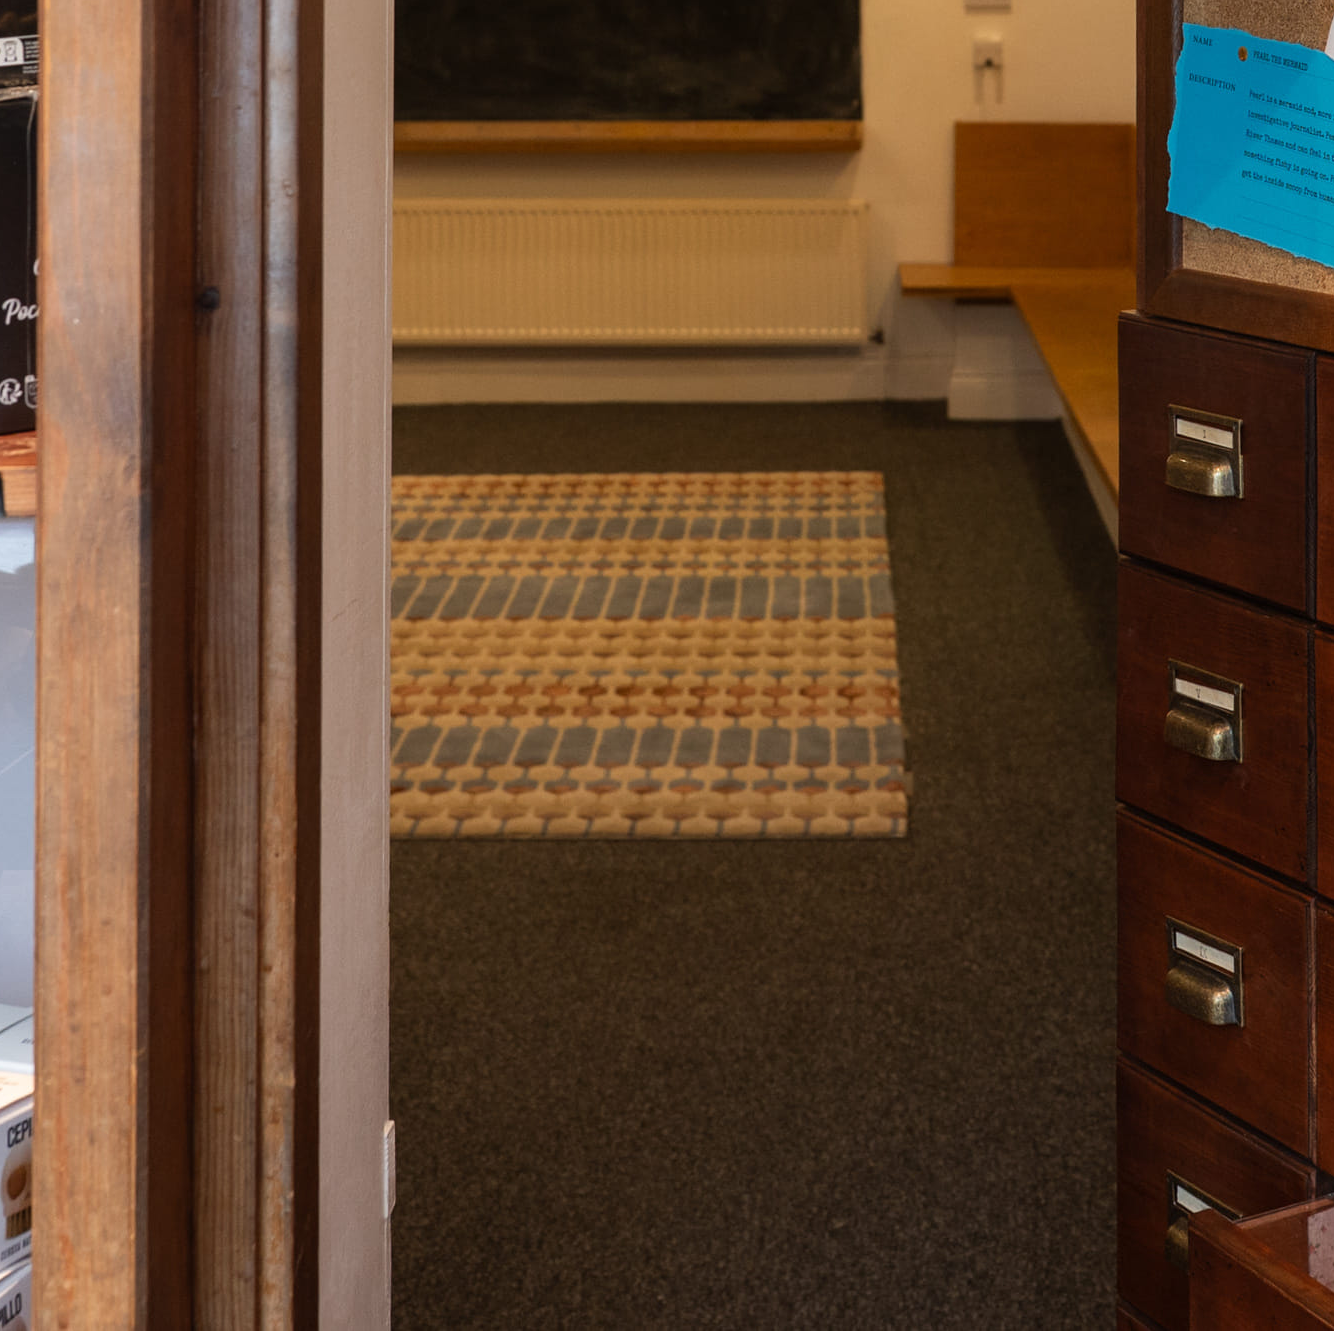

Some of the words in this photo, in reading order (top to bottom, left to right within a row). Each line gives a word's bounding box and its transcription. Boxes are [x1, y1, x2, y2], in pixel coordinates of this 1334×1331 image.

[1193, 36, 1213, 46] NAME
[1253, 50, 1269, 61] PEARL
[1271, 54, 1282, 64] THE
[1189, 73, 1236, 91] DESCRIPTION
